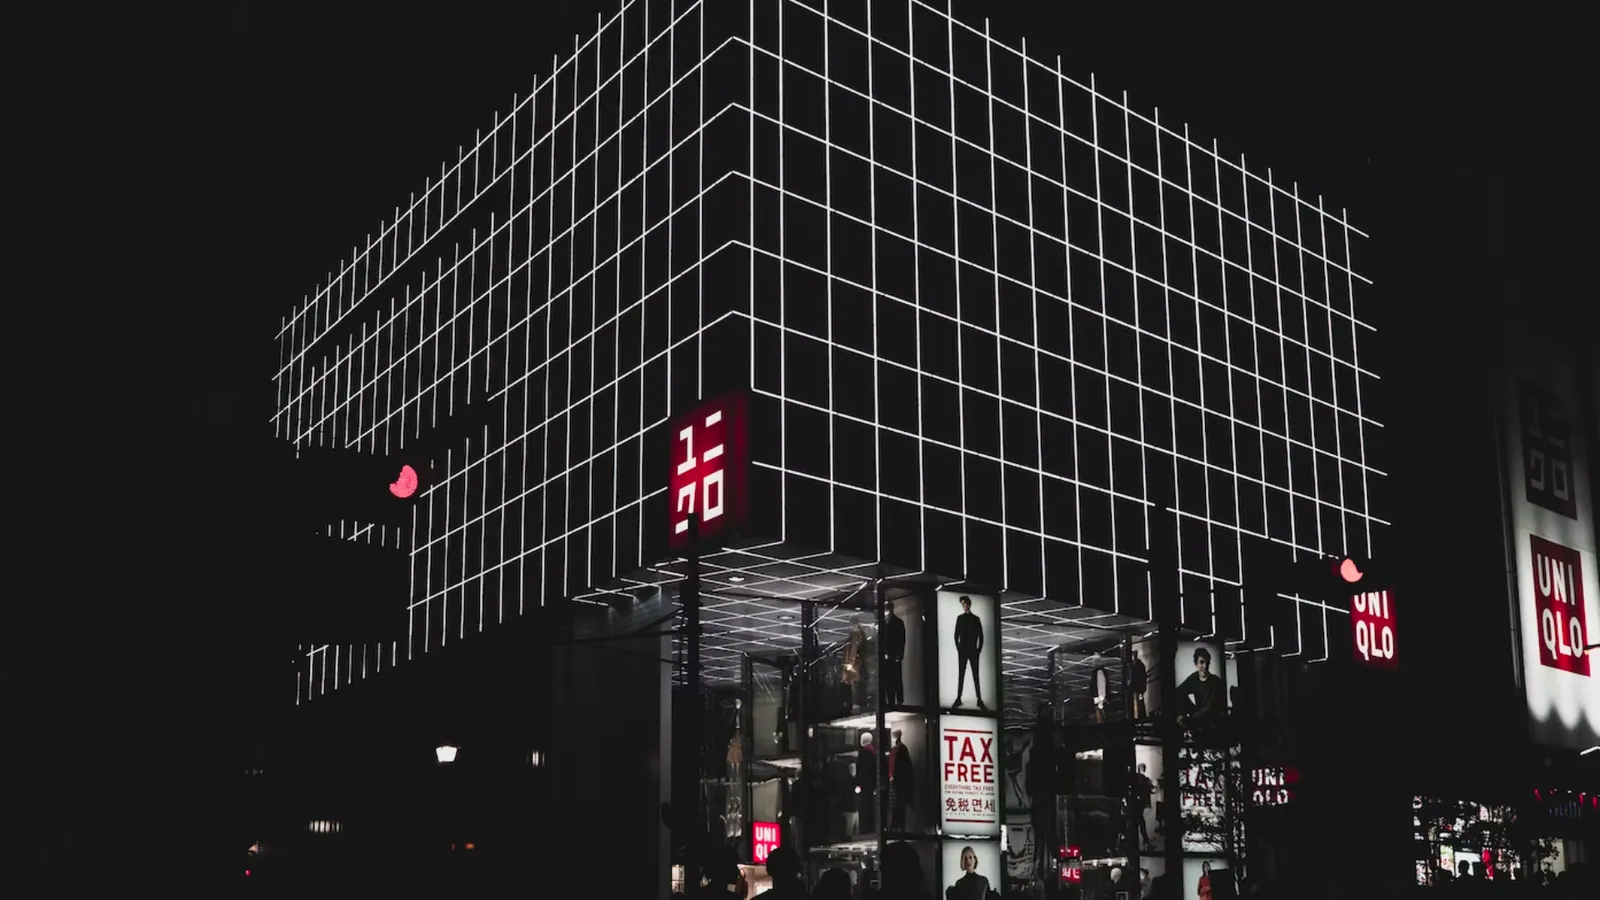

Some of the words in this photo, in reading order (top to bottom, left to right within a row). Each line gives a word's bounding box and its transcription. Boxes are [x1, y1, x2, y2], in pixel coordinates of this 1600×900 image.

[1536, 553, 1576, 605] UNI
[1353, 589, 1389, 619] UNI
[1355, 619, 1394, 661] QLO
[1542, 609, 1584, 661] QLO
[944, 735, 993, 763] TAX
[944, 762, 994, 783] FREE
[972, 798, 995, 813] 면세
[755, 826, 776, 842] UNI
